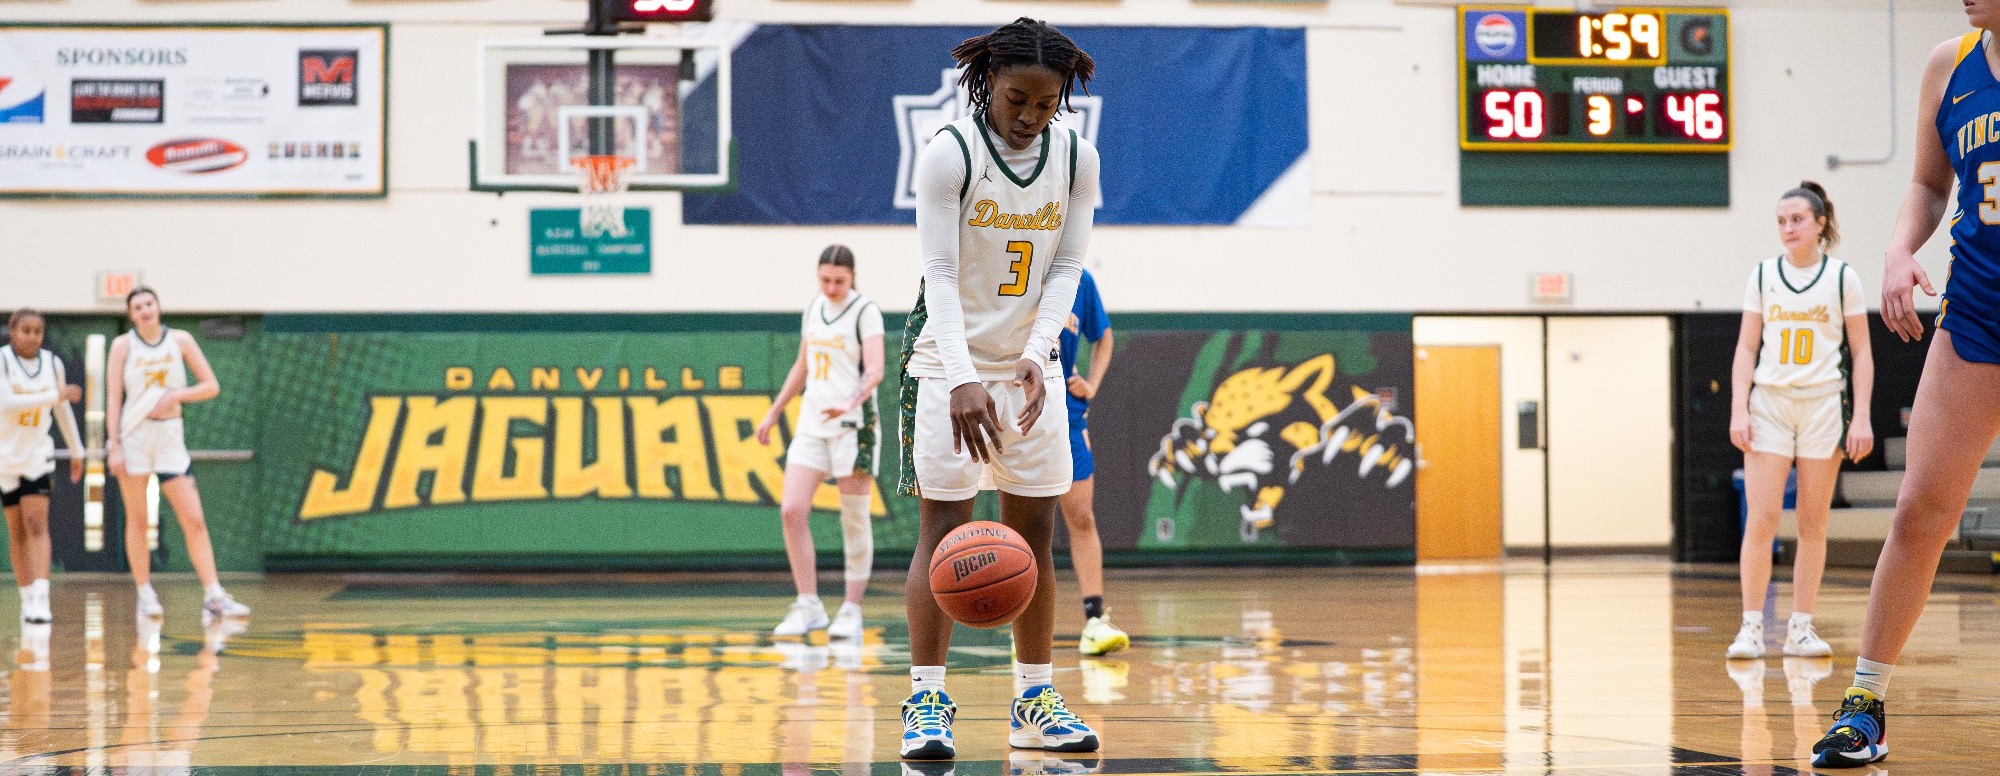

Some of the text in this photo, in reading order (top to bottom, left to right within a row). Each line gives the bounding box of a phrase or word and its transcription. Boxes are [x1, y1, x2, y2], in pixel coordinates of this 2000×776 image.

[1578, 13, 1660, 61] 1:59
[57, 48, 188, 66] SPONSORS
[1476, 64, 1537, 88] HOME
[1572, 76, 1624, 94] PERIOD
[1653, 66, 1718, 89] GUEST
[1484, 90, 1544, 139] 50
[1587, 95, 1613, 136] 3
[1666, 92, 1724, 140] 46
[967, 199, 1062, 230] Danville
[998, 240, 1033, 297] 3
[1767, 304, 1829, 323] Danville
[1779, 327, 1814, 365] 10
[445, 366, 744, 390] DANVILLE
[939, 527, 1007, 554] SPALDING
